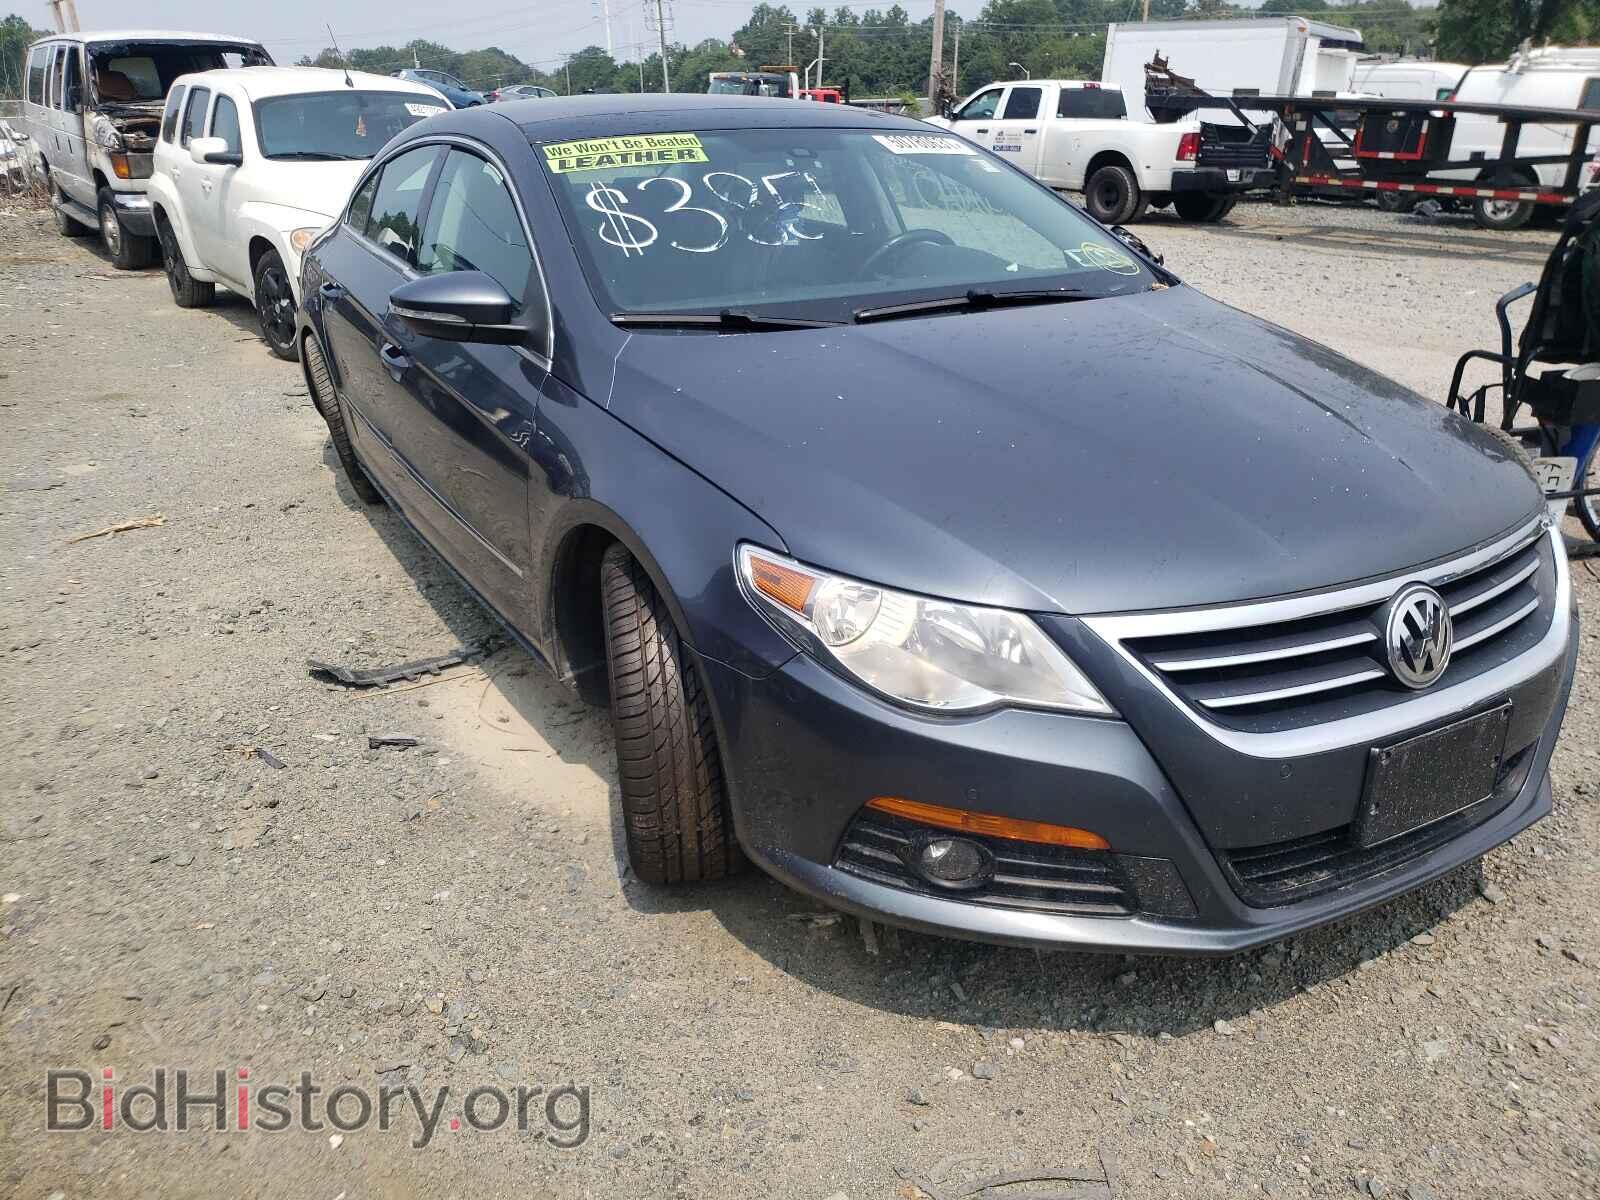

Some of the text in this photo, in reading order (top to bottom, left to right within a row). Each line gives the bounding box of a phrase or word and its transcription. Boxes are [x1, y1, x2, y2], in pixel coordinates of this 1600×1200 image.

[545, 135, 700, 157] We Won't Be Beaten
[558, 148, 697, 171] LEATHER
